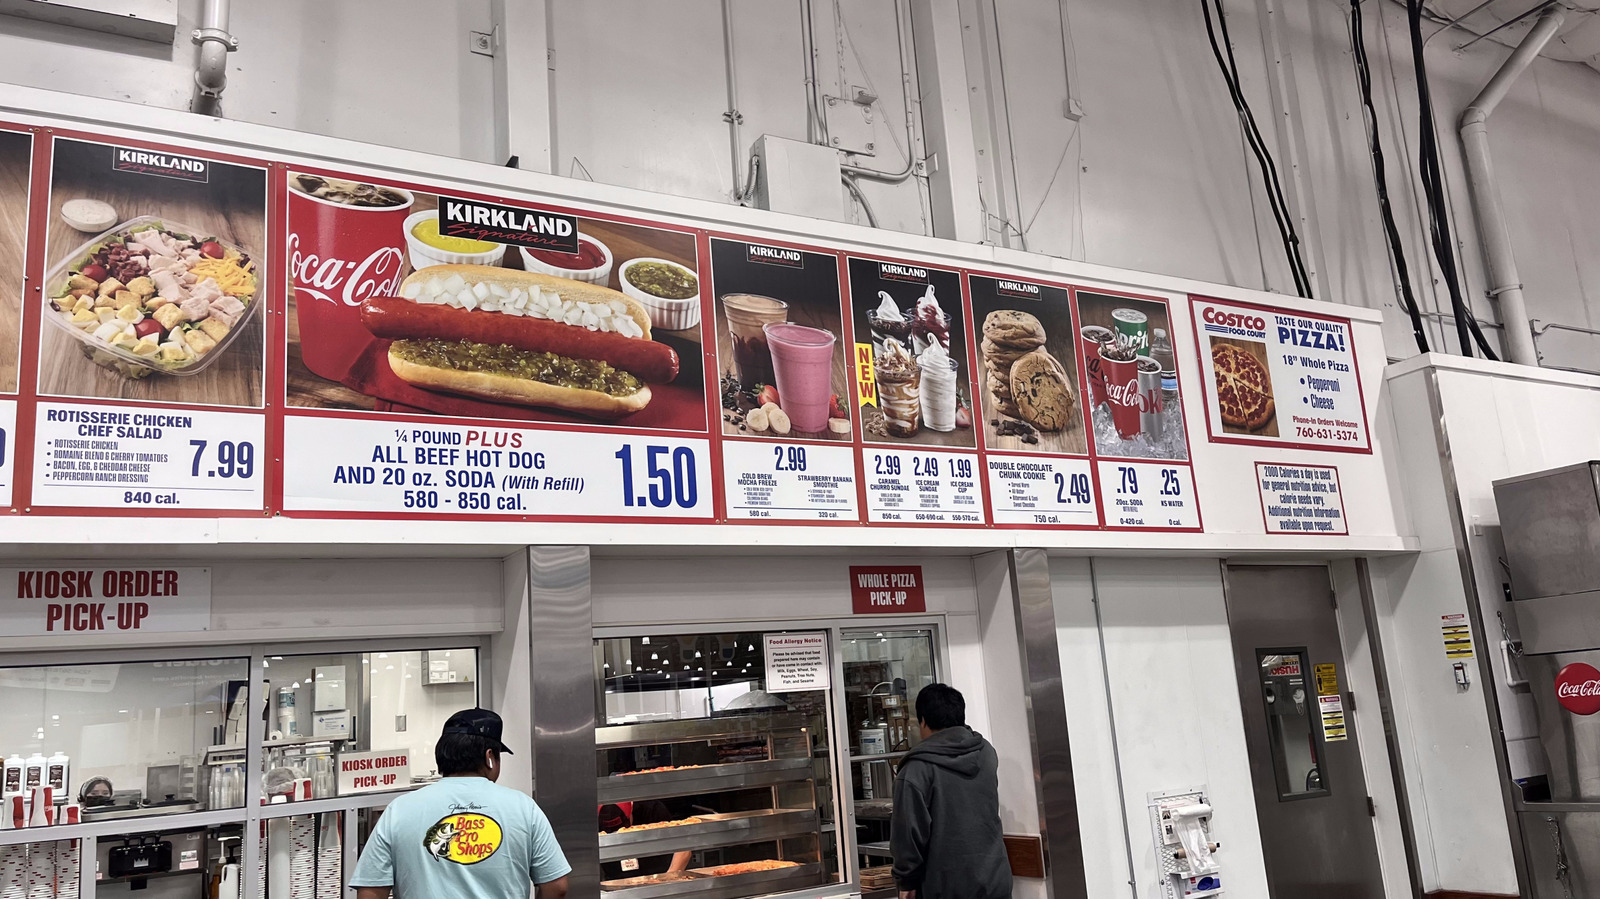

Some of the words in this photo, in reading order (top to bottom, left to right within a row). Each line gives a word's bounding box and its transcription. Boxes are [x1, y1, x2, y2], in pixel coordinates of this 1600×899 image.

[120, 150, 204, 172] KIRKLAND
[447, 202, 572, 237] KIRKLAND
[447, 223, 573, 247] Signature
[750, 246, 801, 261] KIRKLAND
[882, 264, 926, 277] KIRKLAND
[999, 281, 1039, 294] KIRKLAND
[1202, 307, 1265, 331] COSTCO
[1275, 316, 1295, 326] TASTE
[1298, 319, 1313, 330] OUR
[1315, 321, 1343, 334] QUALITY
[1228, 328, 1246, 337] FOOD
[1247, 330, 1266, 339] COURT
[1277, 326, 1345, 352] PIZZA!
[859, 347, 874, 398] NEW
[1300, 356, 1325, 369] Whole
[1327, 360, 1349, 373] Pizza
[1307, 375, 1340, 392] Pepperoni
[1309, 393, 1334, 410] Cheese
[47, 409, 131, 425] ROTISSERIE
[133, 414, 192, 429] CHICKEN
[1317, 417, 1335, 426] Orders
[1335, 419, 1358, 428] Welcome
[77, 424, 114, 437] CHEF
[116, 426, 163, 440] SALAD
[412, 430, 461, 445] POUND
[465, 430, 523, 448] PLUS
[1296, 426, 1358, 441] 760-631-5374
[54, 439, 90, 450] ROTISSERIE
[91, 440, 119, 451] CHICKEN
[54, 450, 83, 460] ROMAINE
[84, 450, 105, 461] BLEND
[111, 452, 135, 462] CHERRY
[135, 453, 168, 463] TOMATOES
[189, 440, 254, 479] 7.99
[371, 445, 408, 464] ALL
[415, 447, 460, 466] BEEF
[466, 450, 503, 468] HOT
[508, 451, 545, 470] DOG
[774, 446, 806, 472] 2.99
[874, 454, 901, 475] 2.99
[98, 462, 128, 472] CHEDDAR
[128, 463, 151, 473] CHEESE
[913, 456, 939, 477] 2.49
[948, 458, 972, 478] 1.99
[989, 461, 1015, 470] DOUBLE
[1016, 463, 1053, 472] CHOCOLATE
[999, 470, 1022, 479] CHUNK
[1022, 471, 1046, 480] COOKIE
[1264, 466, 1279, 477] 2000
[1279, 466, 1300, 478] Calories
[1304, 468, 1314, 481] day
[1313, 469, 1319, 479] is
[1319, 470, 1331, 480] used
[52, 471, 94, 482] PEPPERCORN
[95, 472, 117, 482] RANCH
[117, 473, 149, 483] DRESSING
[333, 466, 376, 485] AND
[382, 467, 406, 486] 20
[412, 473, 438, 488] oz.
[445, 470, 496, 488] SODA
[501, 474, 541, 492] (With
[543, 475, 585, 494] Refill)
[615, 443, 698, 510] 1.50
[757, 473, 773, 481] BREW
[1117, 466, 1139, 494] .79
[1160, 468, 1181, 496] .25
[1054, 472, 1091, 504] 2.49
[1262, 478, 1271, 490] for
[1271, 480, 1290, 492] general
[1290, 480, 1311, 492] nutrition
[1328, 482, 1337, 493] but
[124, 491, 152, 504] 840
[155, 492, 180, 504] cal.
[404, 490, 440, 509] 580
[458, 491, 490, 511] 850
[496, 493, 527, 511] cal.
[1115, 498, 1129, 506] 20oz.
[1279, 493, 1297, 504] calorie
[1297, 494, 1312, 505] needs
[1034, 515, 1047, 523] 750
[1048, 515, 1061, 523] cal.
[1268, 505, 1292, 517] Additional
[1292, 506, 1314, 518] nutrition
[1313, 507, 1340, 518] information
[1279, 518, 1301, 530] available
[1301, 520, 1314, 532] upon
[17, 570, 94, 599] KIOSK
[102, 569, 179, 598] ORDER
[857, 573, 890, 588] WHOLE
[891, 573, 916, 588] PIZZA
[870, 591, 907, 606] PICK-UP
[46, 602, 149, 631] PICK-UP
[342, 758, 373, 772] KIOSK
[375, 755, 407, 769] ORDER
[455, 817, 485, 831] Bass
[455, 830, 478, 842] Pro
[457, 841, 493, 858] Shops
